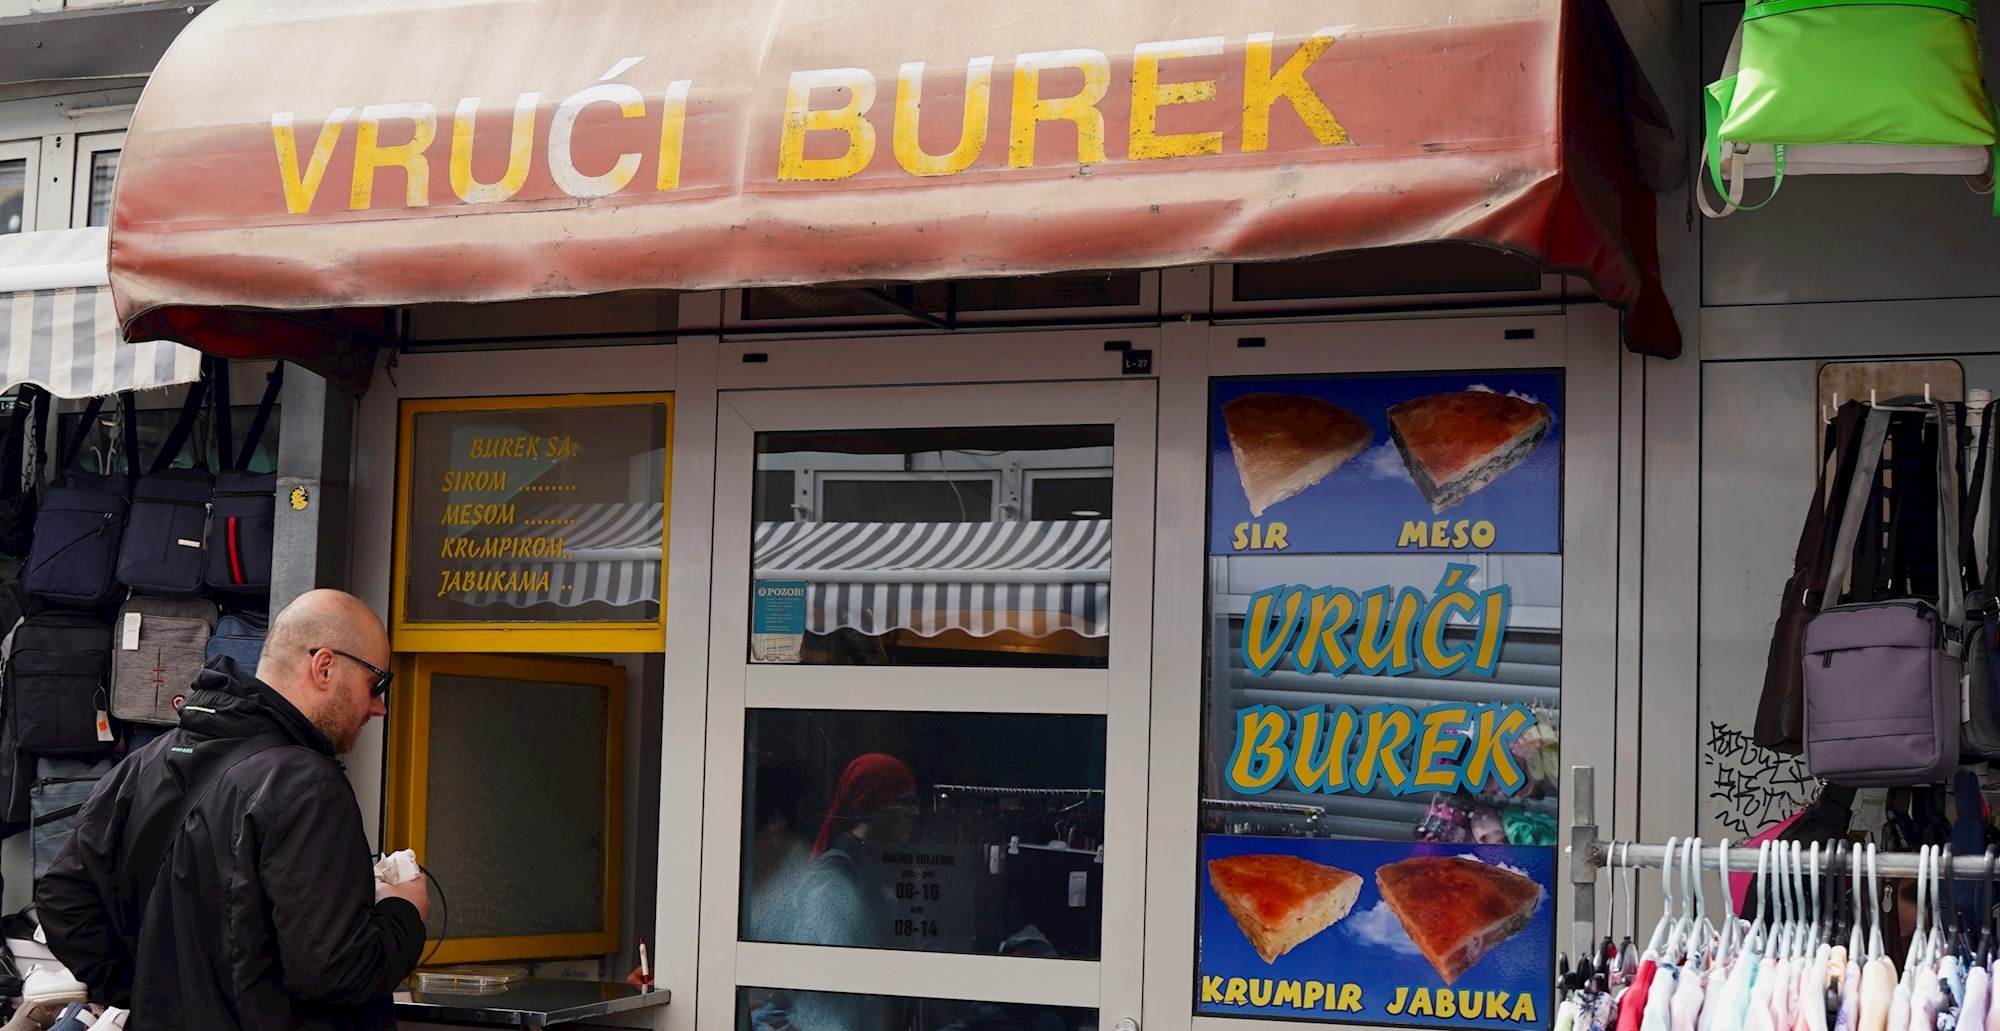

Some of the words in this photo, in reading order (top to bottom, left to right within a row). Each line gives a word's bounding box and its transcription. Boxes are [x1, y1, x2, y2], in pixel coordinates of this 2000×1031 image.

[271, 56, 693, 214] VRUĆI
[777, 24, 1355, 183] BUREK
[470, 436, 541, 459] BUREK
[441, 470, 508, 492] SIROM
[441, 503, 516, 525] MESOM
[1232, 521, 1291, 551] SIR
[1397, 519, 1496, 549] MESO
[437, 570, 550, 597] JABUKAMA
[767, 587, 804, 596] POZOR!
[1242, 562, 1508, 677] VRUĆI
[1225, 701, 1536, 797] BUREK
[896, 883, 939, 901] 08-16
[895, 919, 938, 937] 08-14
[1201, 975, 1364, 1013] KRUMPIR
[1386, 986, 1537, 1022] JABUKA
